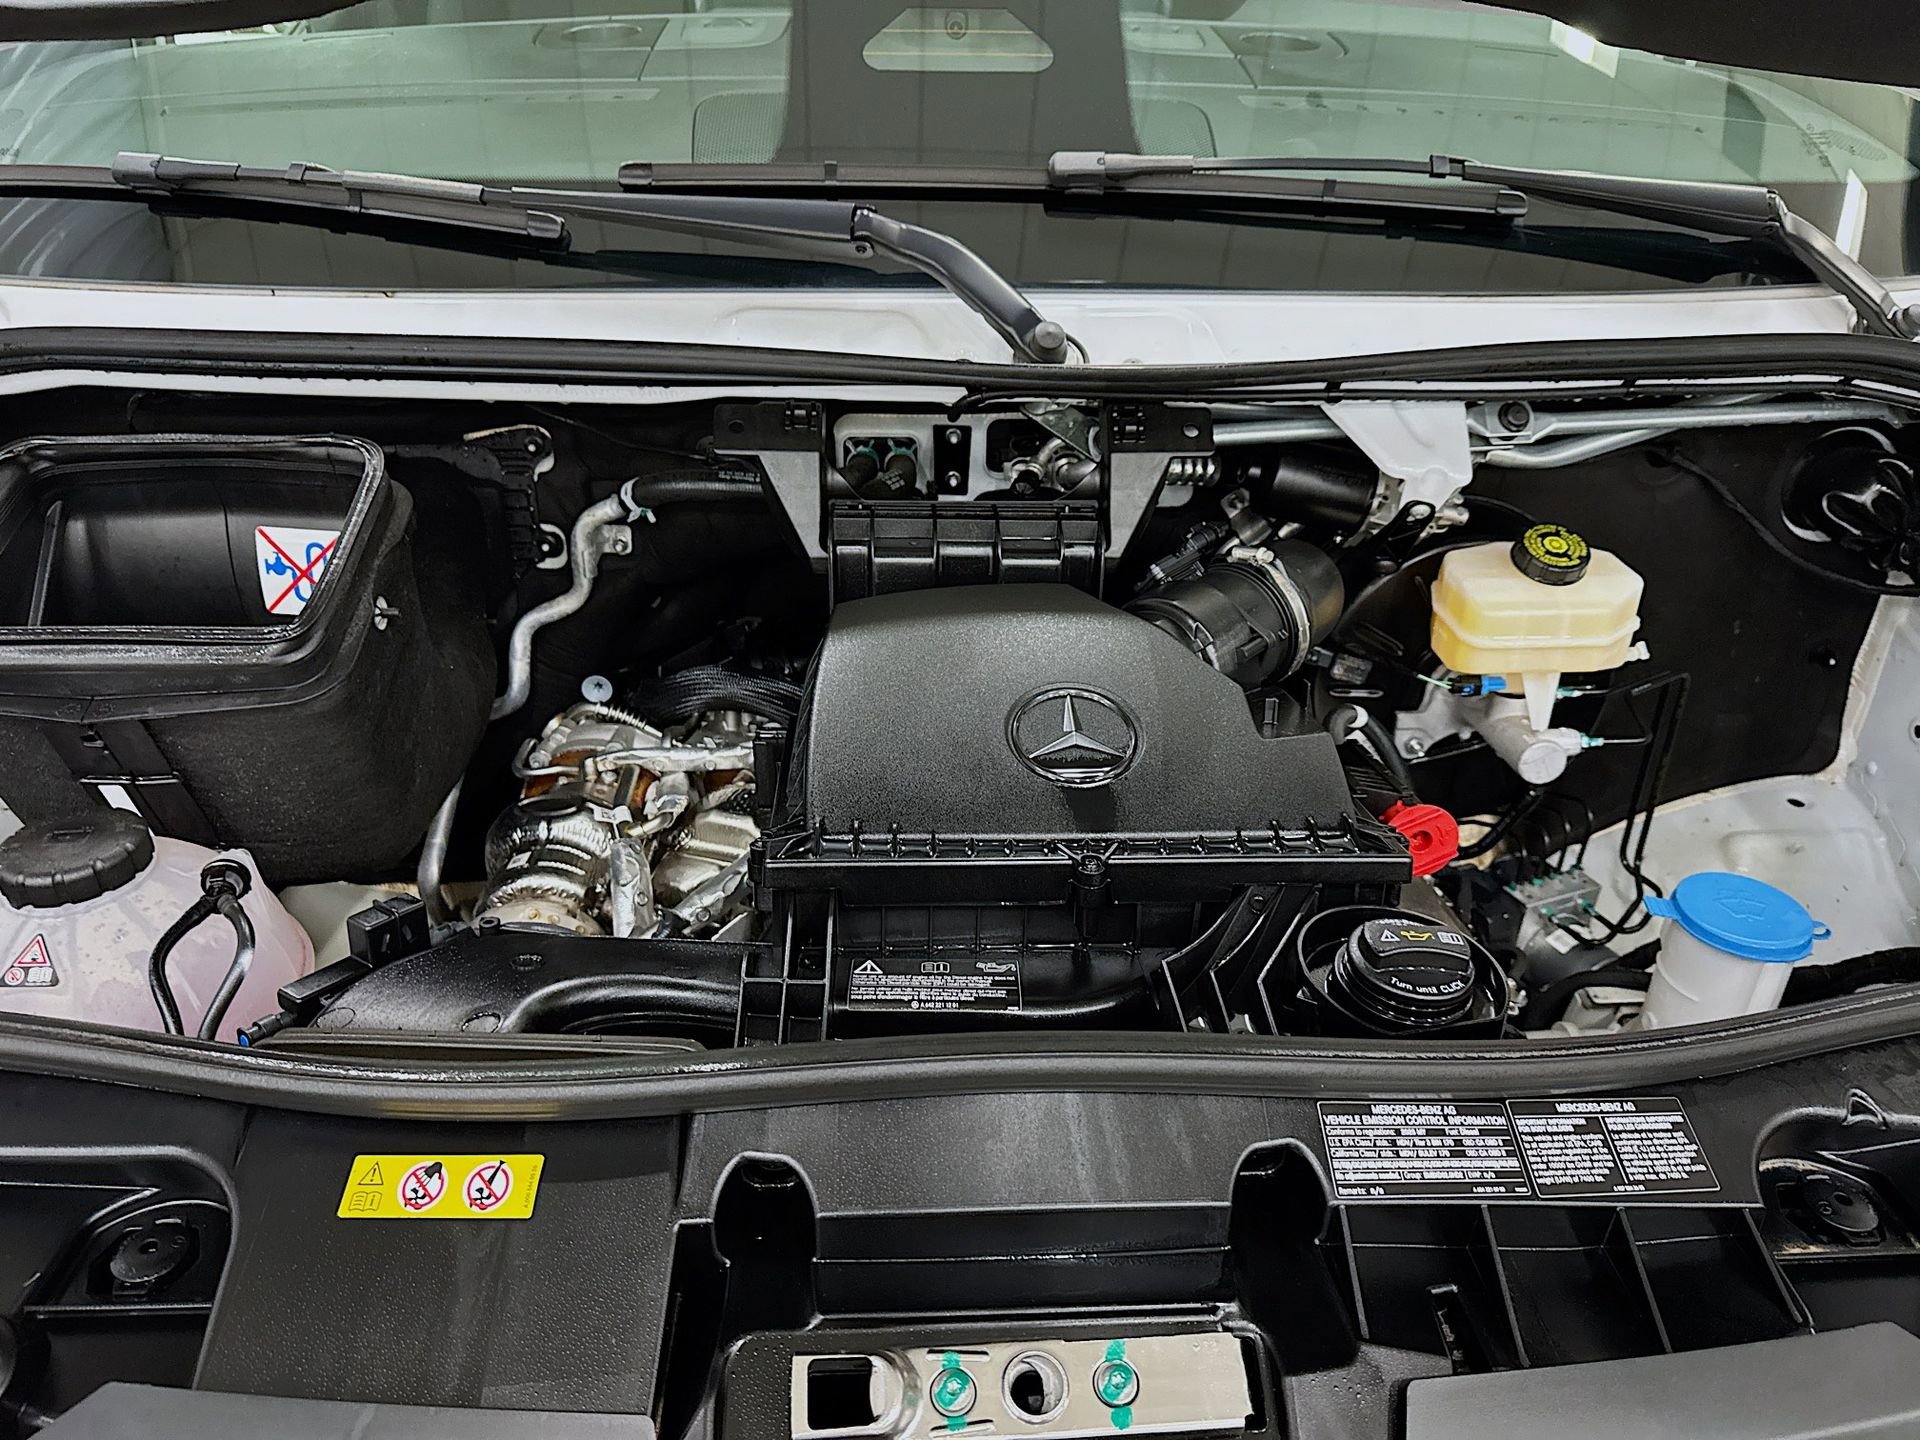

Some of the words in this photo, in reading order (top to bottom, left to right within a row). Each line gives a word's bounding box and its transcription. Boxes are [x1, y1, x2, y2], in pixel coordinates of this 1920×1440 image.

[1390, 976, 1413, 991] Turn
[1416, 985, 1438, 994] until
[1440, 979, 1466, 994] CLICK
[1371, 1105, 1444, 1115] MERCEDES-BENZ
[1442, 1105, 1457, 1115] AG
[1554, 1102, 1624, 1113] MERCEDES-BENZ
[1621, 1101, 1637, 1111] AG
[1323, 1115, 1362, 1125] VEHICLE
[1361, 1115, 1406, 1125] EMISSION
[1405, 1115, 1448, 1125] CONTROL
[1447, 1115, 1507, 1125] INFORMATION
